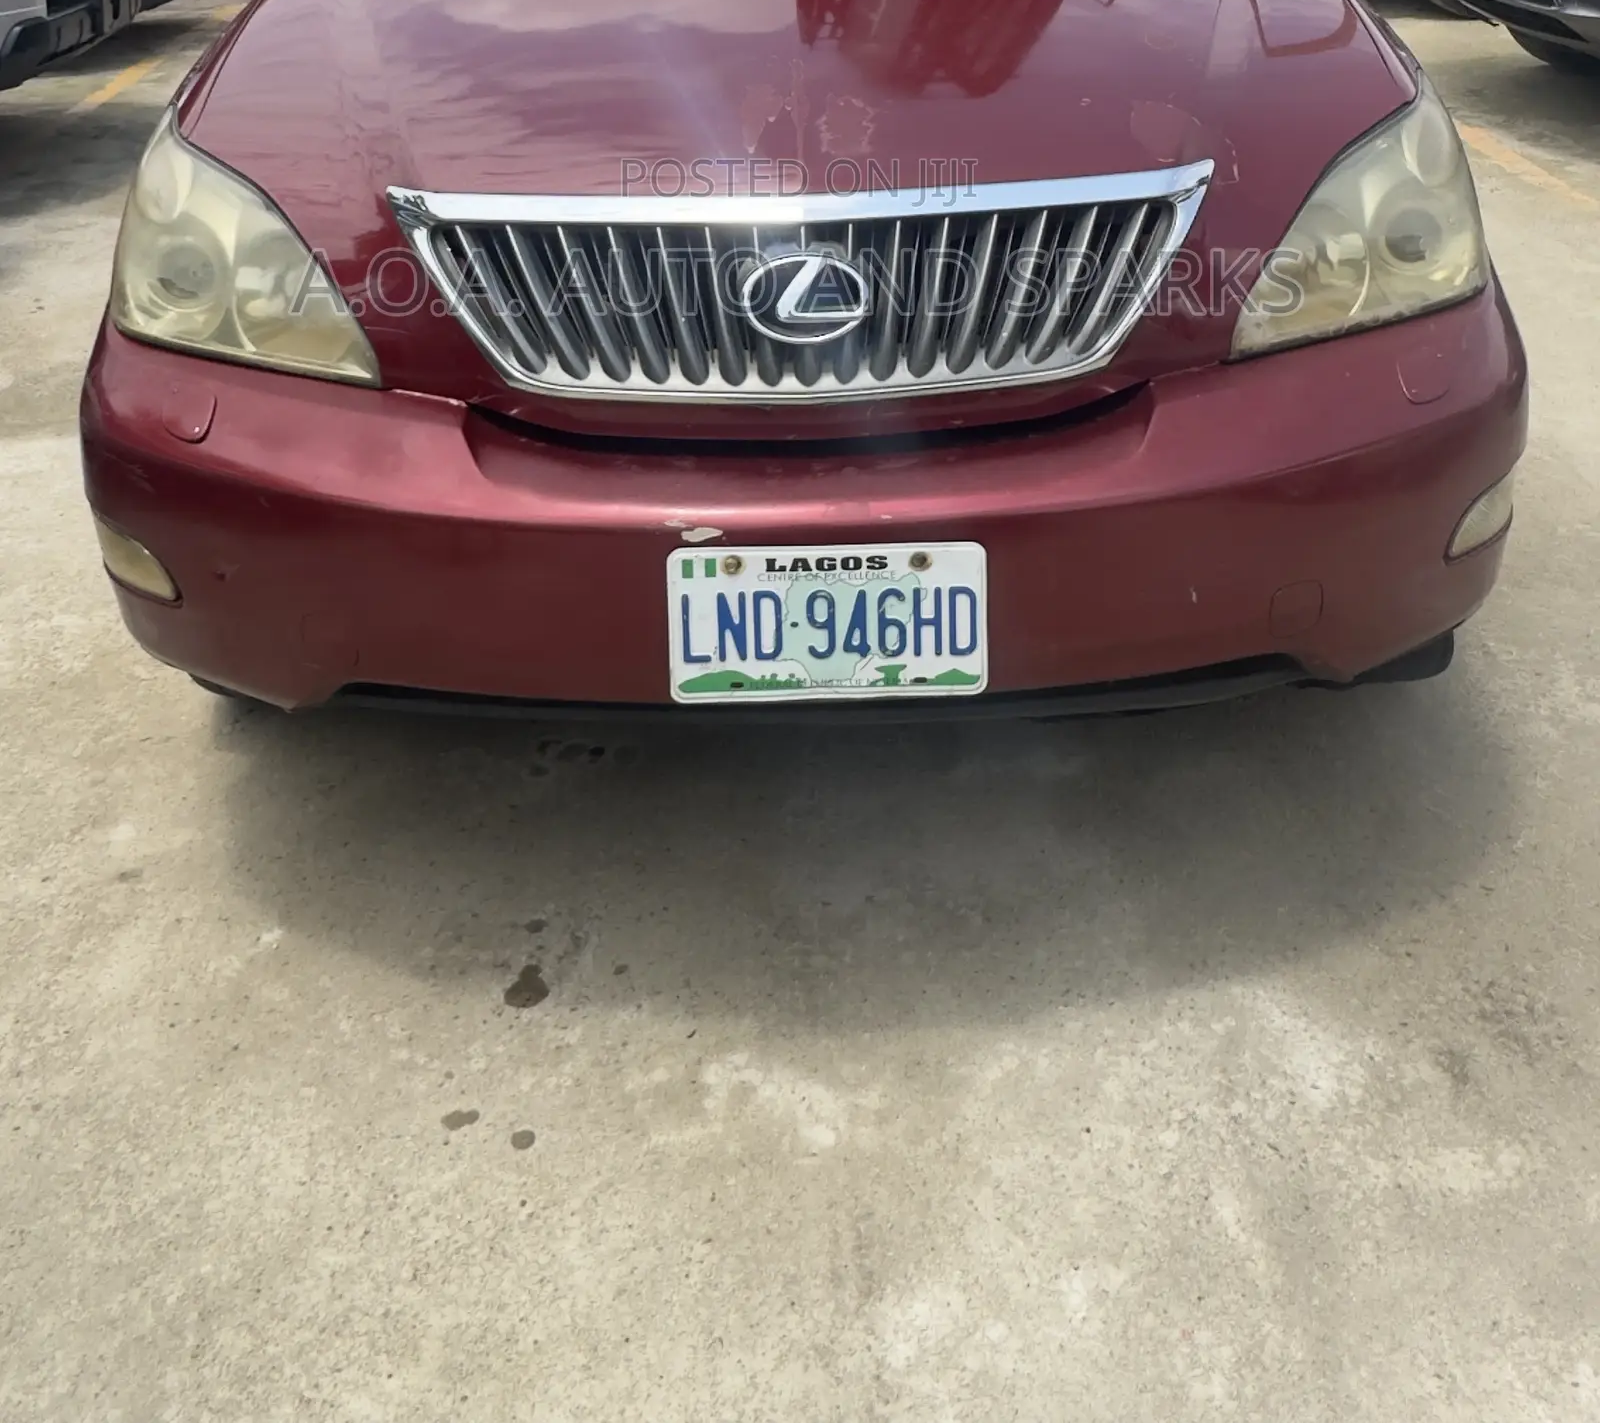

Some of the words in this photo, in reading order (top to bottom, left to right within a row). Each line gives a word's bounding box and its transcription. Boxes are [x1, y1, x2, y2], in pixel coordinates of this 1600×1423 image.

[765, 555, 888, 572] LAGOS
[757, 572, 799, 582] CENTRE
[804, 572, 821, 582] OF
[823, 570, 897, 581] EXCELLENCE
